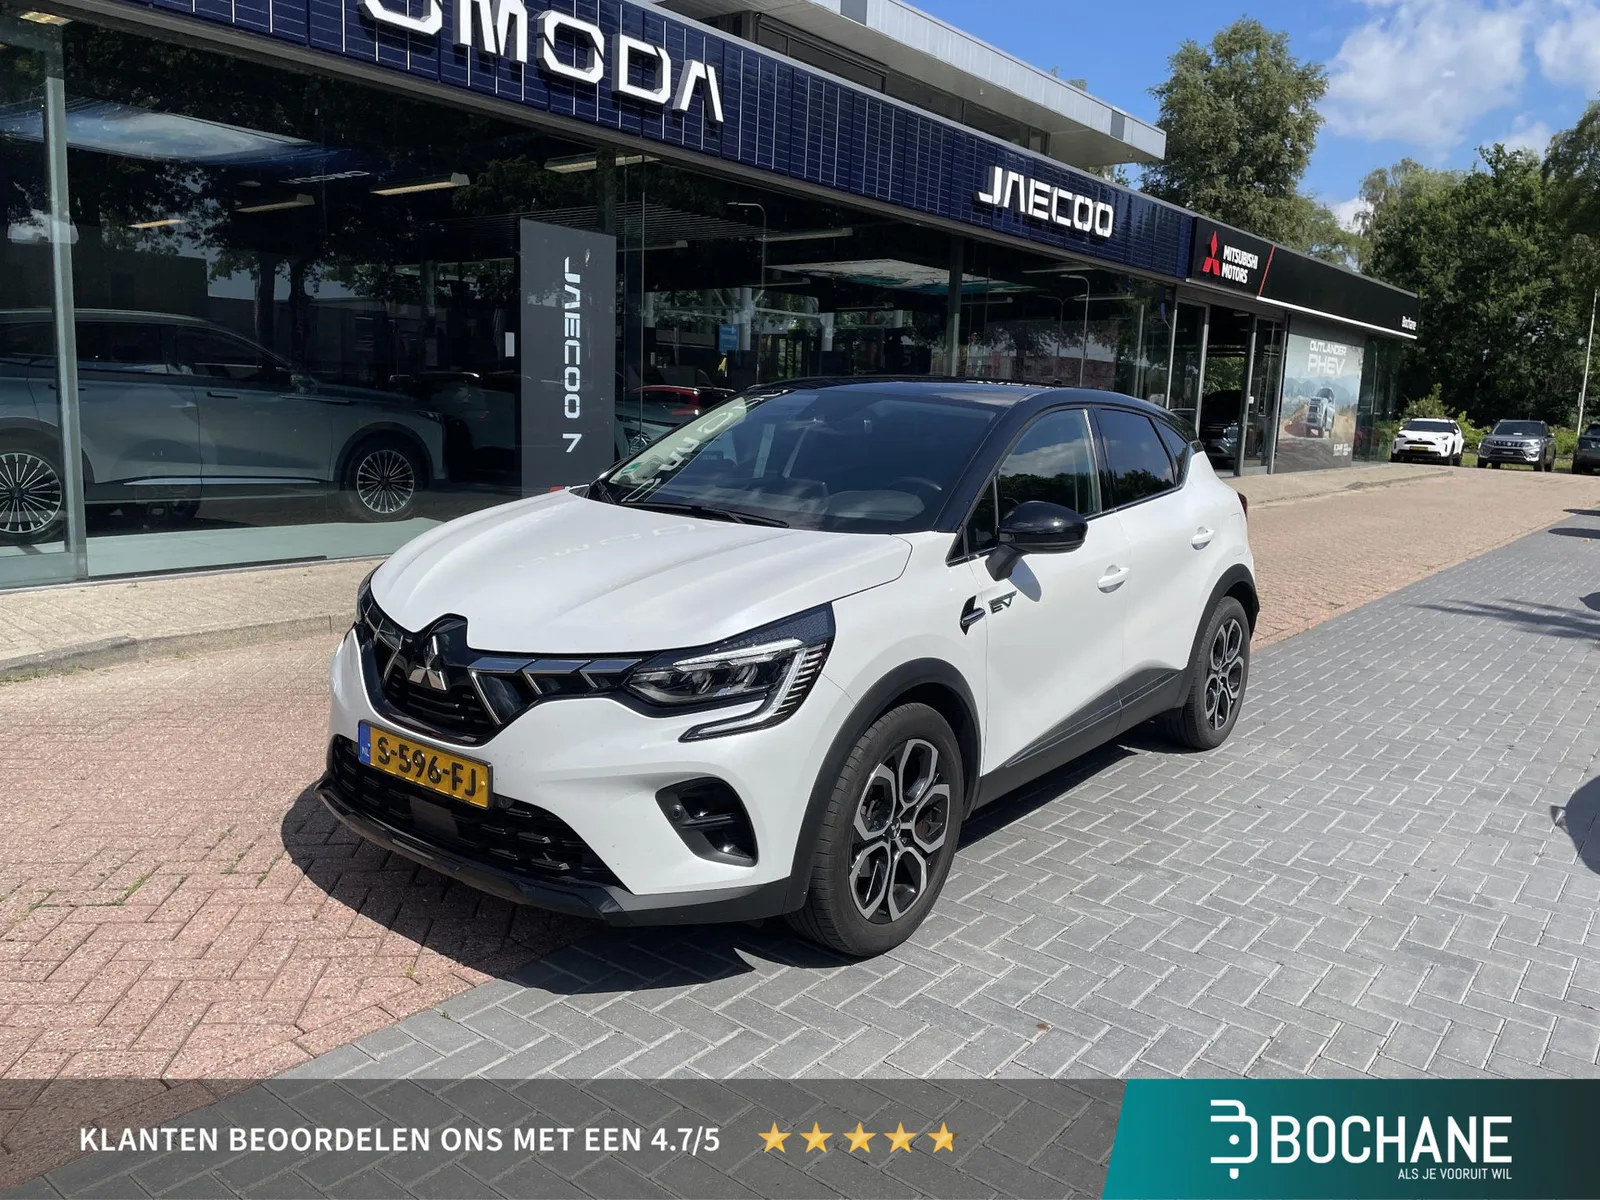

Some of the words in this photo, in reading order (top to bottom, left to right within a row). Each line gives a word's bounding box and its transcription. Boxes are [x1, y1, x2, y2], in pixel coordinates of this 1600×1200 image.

[978, 166, 1114, 239] JAECOO
[1222, 244, 1259, 270] MITSUBISHI
[1221, 262, 1249, 284] MOTORS
[563, 256, 581, 419] JAECOO
[1309, 340, 1347, 356] OUTLANDER
[1307, 353, 1346, 376] PHEV
[562, 433, 583, 453] 7
[377, 736, 477, 797] S-596-FJ
